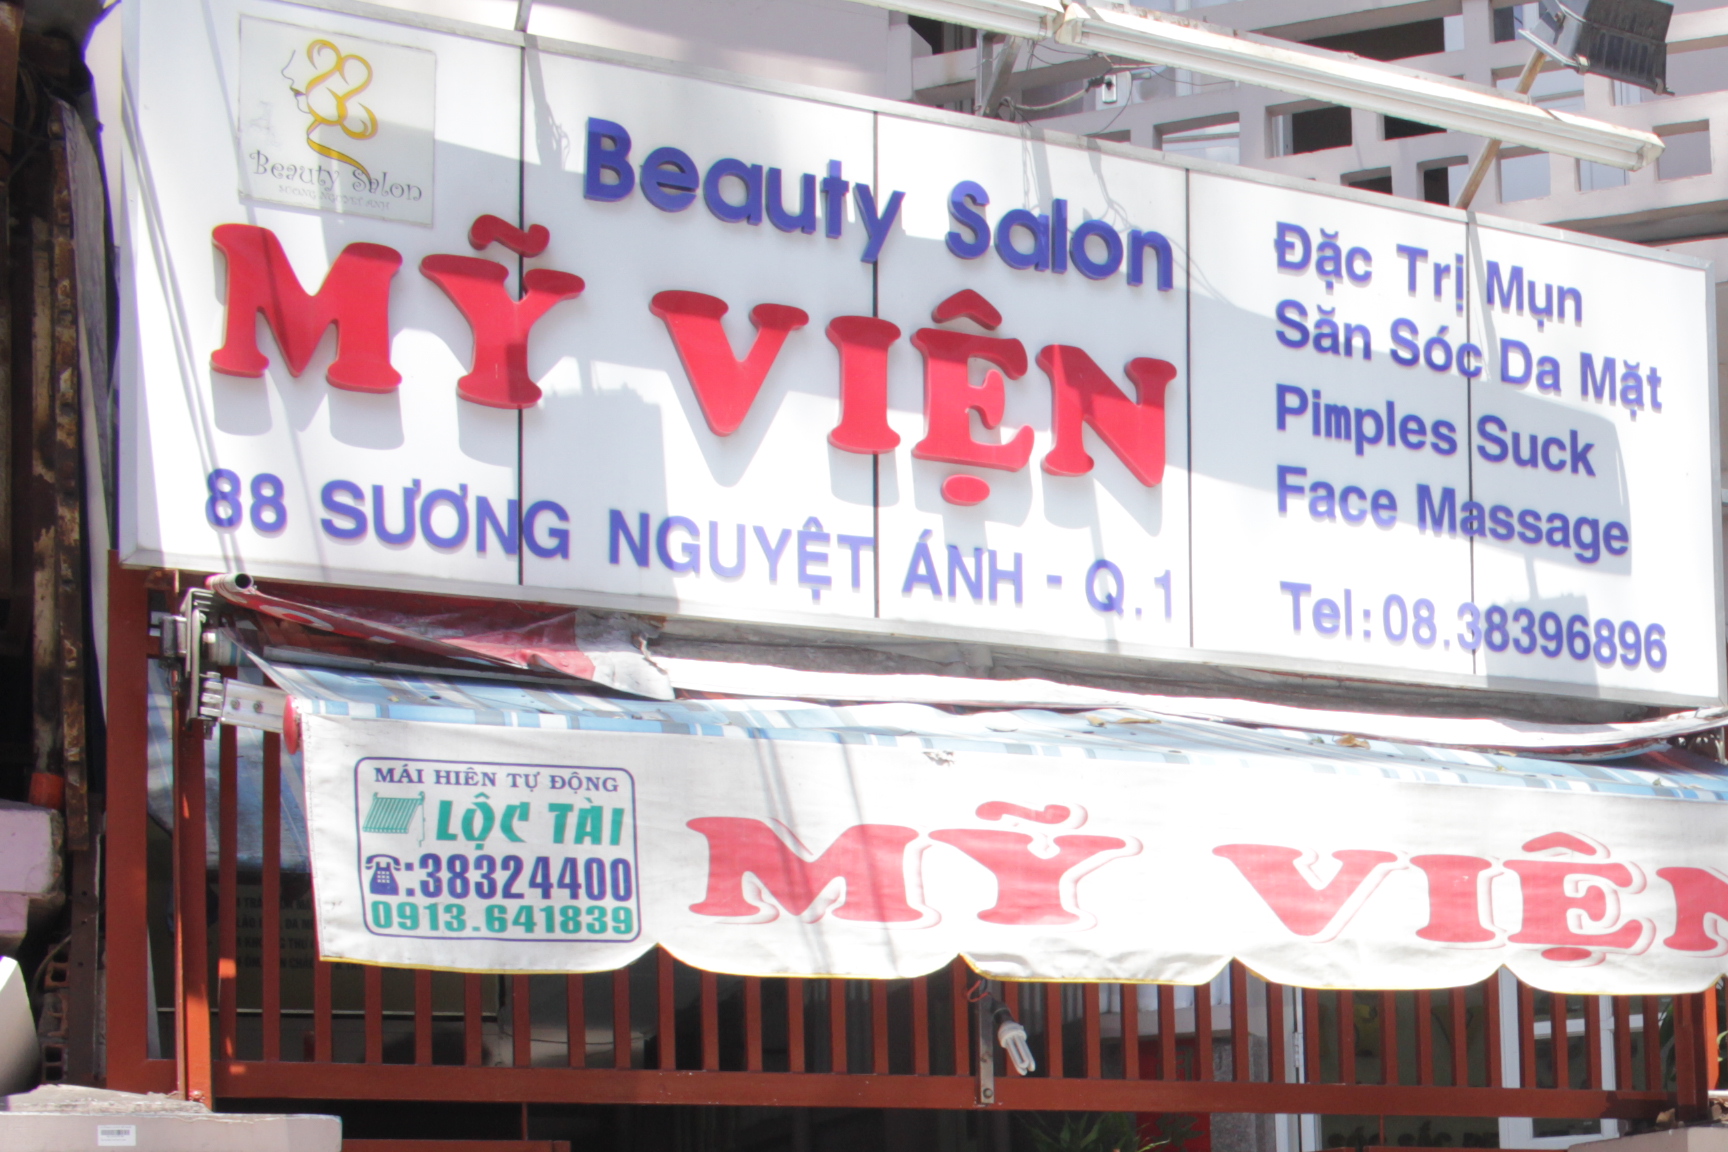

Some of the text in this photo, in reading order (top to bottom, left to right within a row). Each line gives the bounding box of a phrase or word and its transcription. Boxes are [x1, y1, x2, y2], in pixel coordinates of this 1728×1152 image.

[250, 149, 422, 201] Beauty Salon
[584, 117, 1174, 292] Beauty Salon
[1273, 221, 1583, 331] Đặc Trị Mụn
[210, 214, 1177, 506] MỸ VIỆN
[1275, 299, 1663, 420] Săn Sóc Da Mặt
[1275, 383, 1596, 477] Pimples Suck
[205, 468, 287, 532] 88
[321, 478, 570, 560] SƯƠNG
[608, 509, 874, 601] NGUYỆT
[901, 528, 1024, 603] ÁNH
[1085, 559, 1172, 620] Q.1
[1276, 464, 1630, 564] Face Massage
[373, 764, 619, 795] MÁI HIÊN TỰ ĐỘNG
[435, 791, 625, 850] LỘC TÀI
[686, 800, 1138, 928] MỸ
[370, 900, 633, 935] 0913.641839
